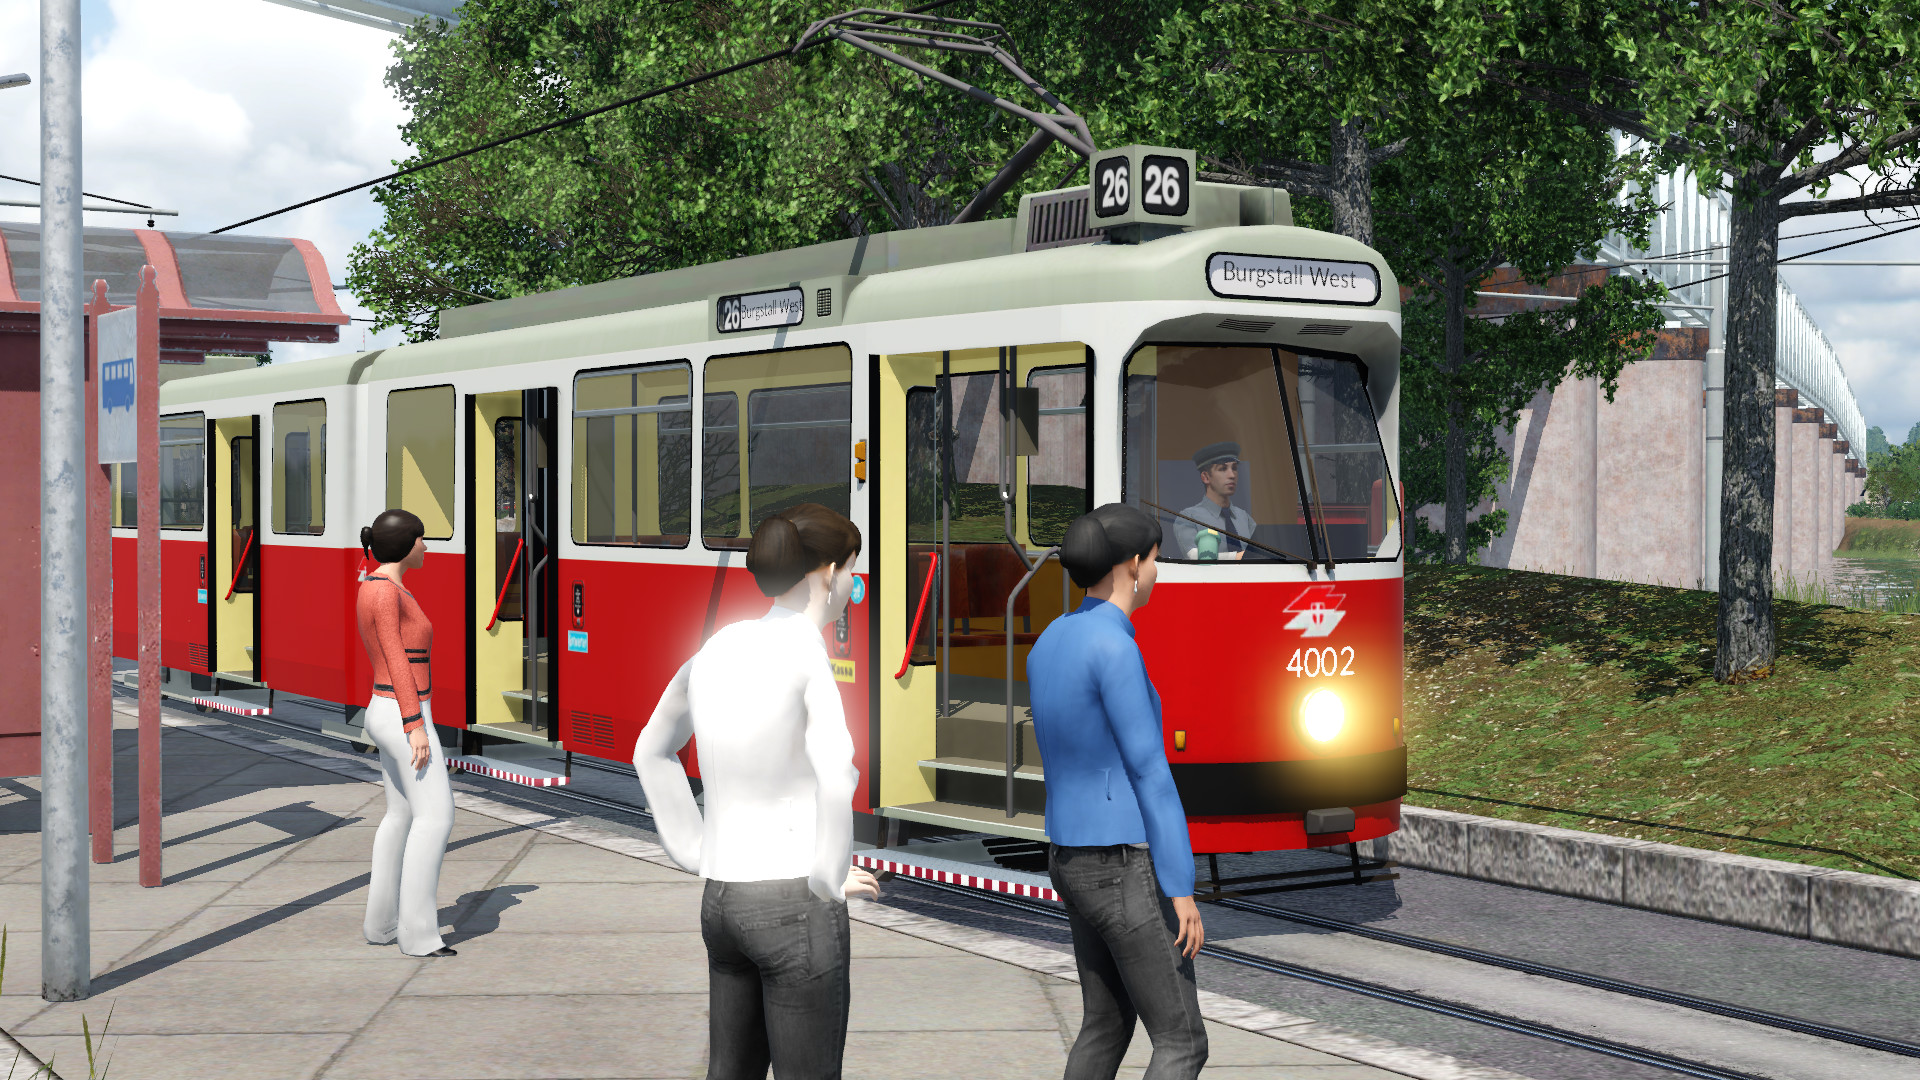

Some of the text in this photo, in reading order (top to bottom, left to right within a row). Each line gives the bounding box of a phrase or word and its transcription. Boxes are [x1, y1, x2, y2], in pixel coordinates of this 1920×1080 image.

[1102, 166, 1129, 208] 26
[1145, 164, 1180, 206] 26
[1223, 260, 1357, 289] Burgstall West
[724, 299, 740, 330] 26
[741, 298, 803, 321] Burgstall West
[1285, 645, 1355, 678] 4002
